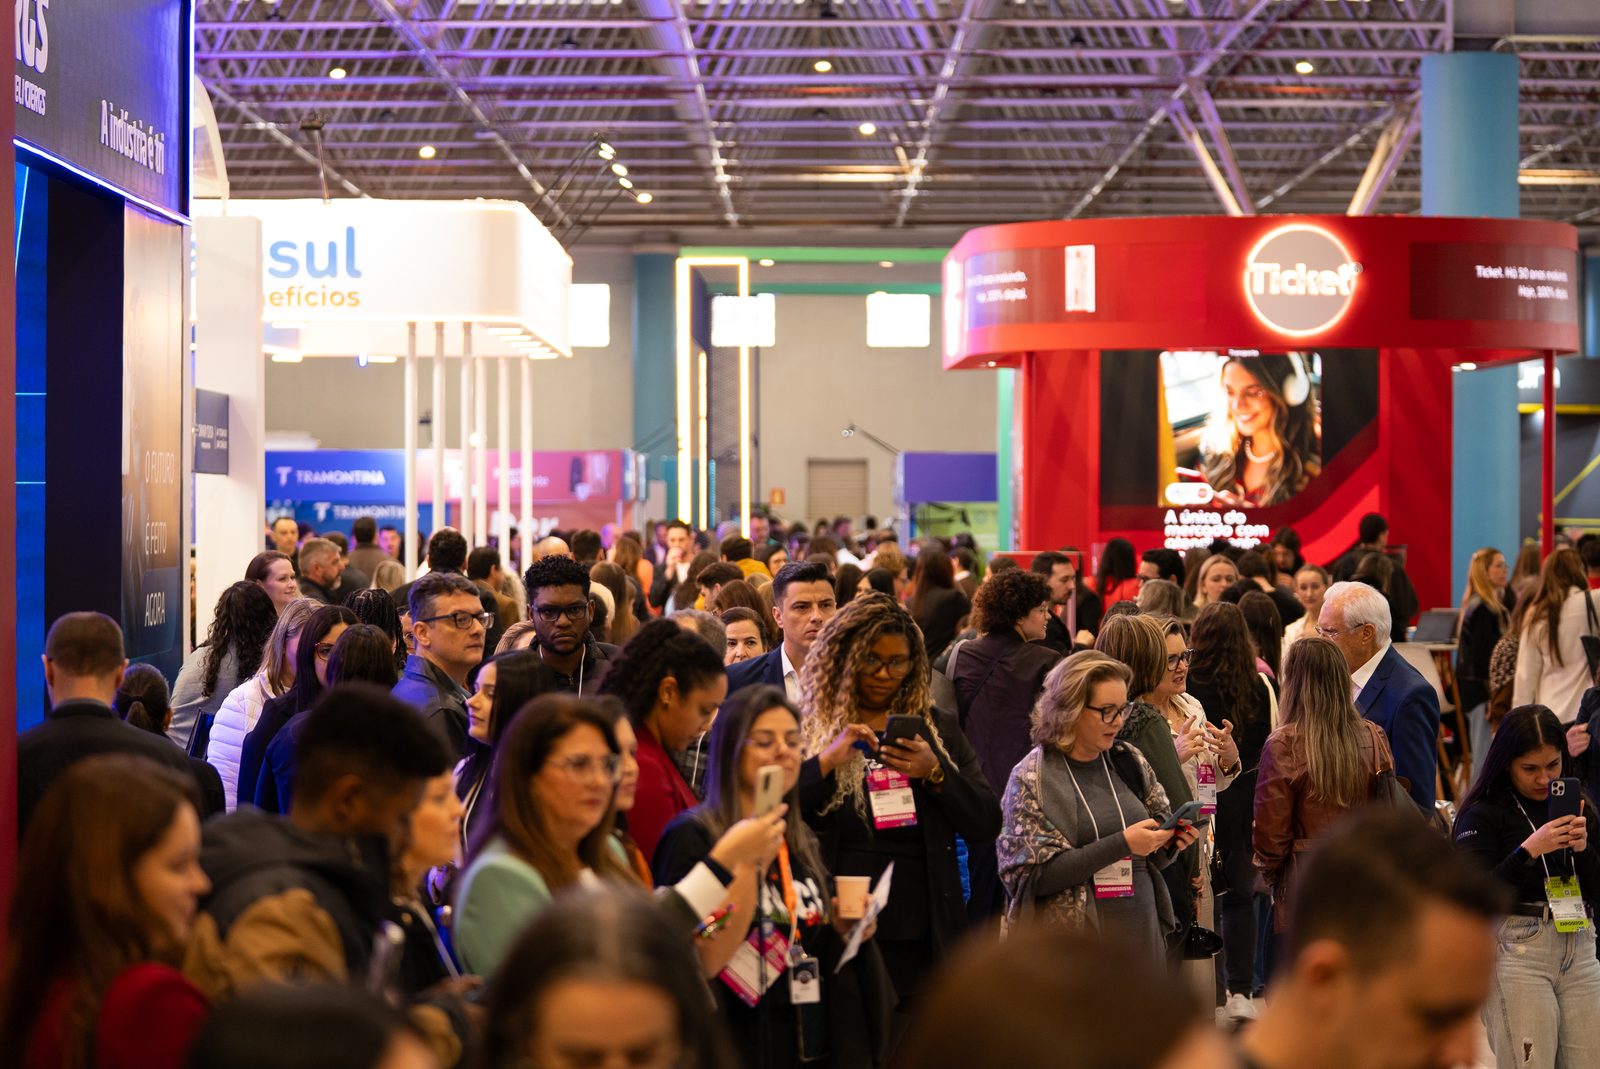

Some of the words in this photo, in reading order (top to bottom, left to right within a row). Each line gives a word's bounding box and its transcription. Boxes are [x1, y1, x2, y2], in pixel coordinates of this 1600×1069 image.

[100, 99, 109, 147] A
[109, 102, 147, 166] indústria
[147, 126, 154, 170] é
[154, 132, 165, 175] tri
[262, 285, 361, 307] efícios
[151, 450, 175, 484] FUTURO
[296, 469, 386, 485] TRAMONTINA
[1164, 509, 1178, 525] A
[151, 522, 167, 554] FEITO
[144, 592, 166, 627] AGORA
